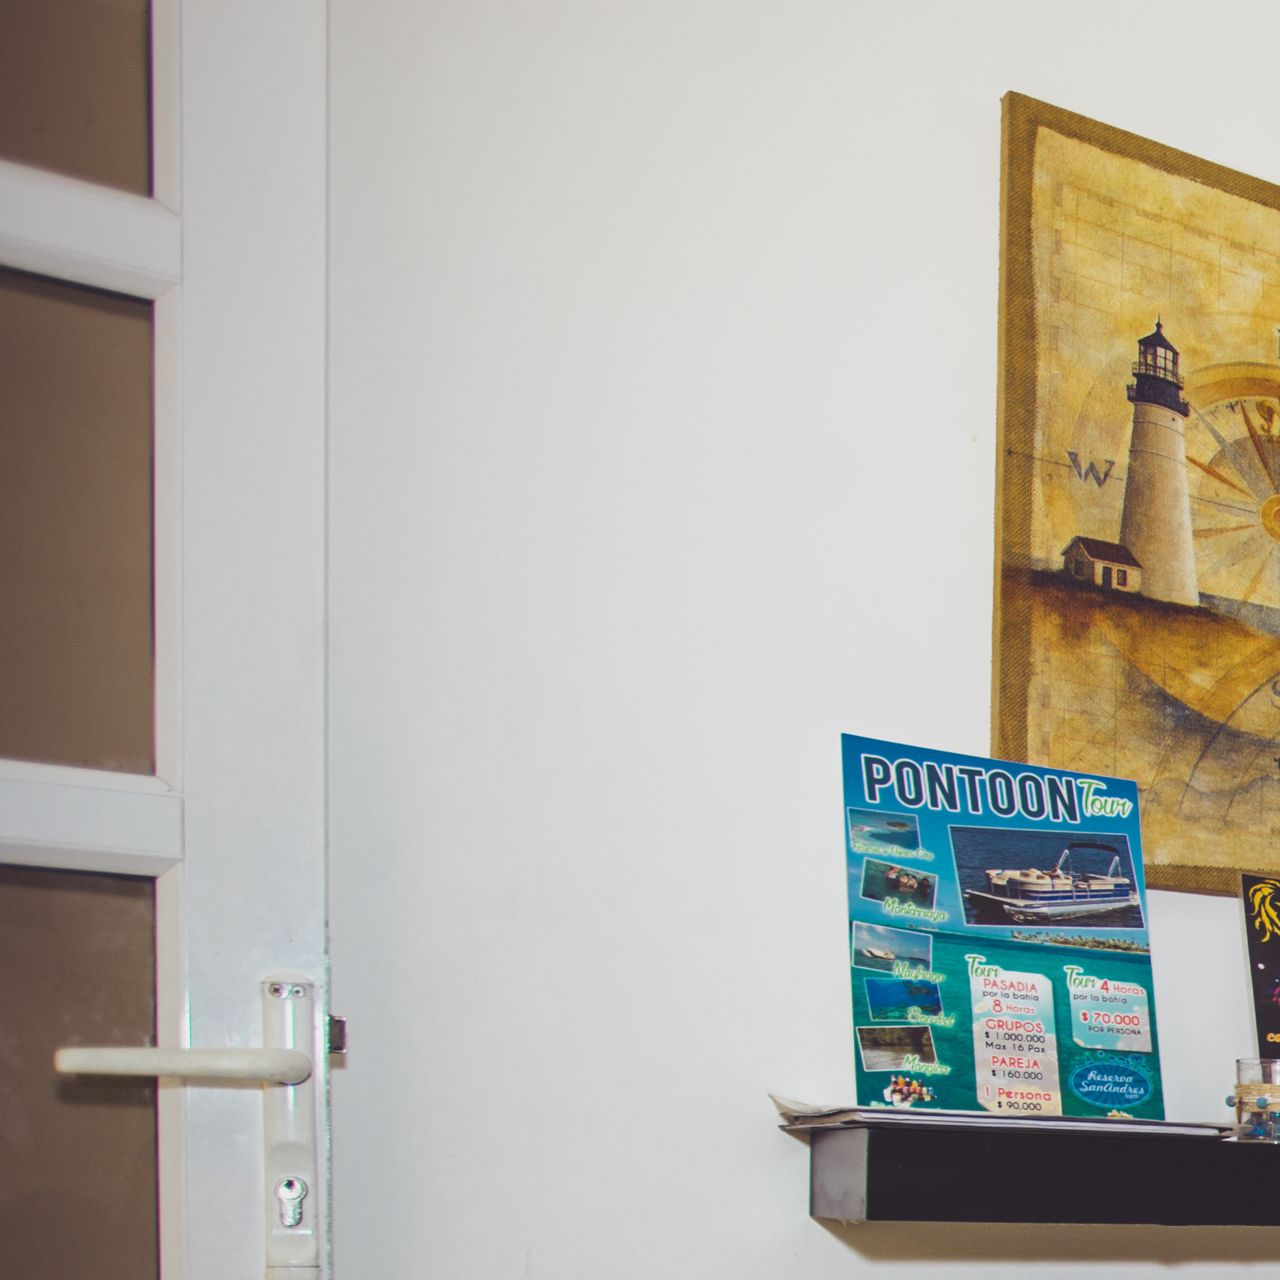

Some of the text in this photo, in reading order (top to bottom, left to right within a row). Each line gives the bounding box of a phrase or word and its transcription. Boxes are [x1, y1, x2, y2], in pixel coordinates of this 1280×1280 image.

[1067, 450, 1115, 488] W
[861, 753, 1134, 824] PONTOON Tour
[966, 956, 999, 978] Tour
[983, 978, 1038, 993] PASADIA
[1066, 966, 1145, 996] Tour 4 Horas
[982, 990, 998, 998] por
[1001, 991, 1010, 999] la
[1073, 993, 1089, 1001] por
[1091, 994, 1099, 1002] la
[992, 999, 1036, 1014] 8 Horas
[1080, 1011, 1140, 1026] $ 70.000
[985, 1019, 1043, 1034] GRUPOS
[1088, 1025, 1142, 1036] POR PERSONA
[985, 1031, 1045, 1043] $ 1.000.000
[985, 1041, 1045, 1053] Max 16 Pax
[992, 1056, 1040, 1069] PAREJA
[992, 1069, 1043, 1080] $ 160.000
[1087, 1070, 1133, 1083] Reserva
[985, 1087, 1052, 1101] 1 Persona
[997, 1101, 1042, 1111] $ 90.000
